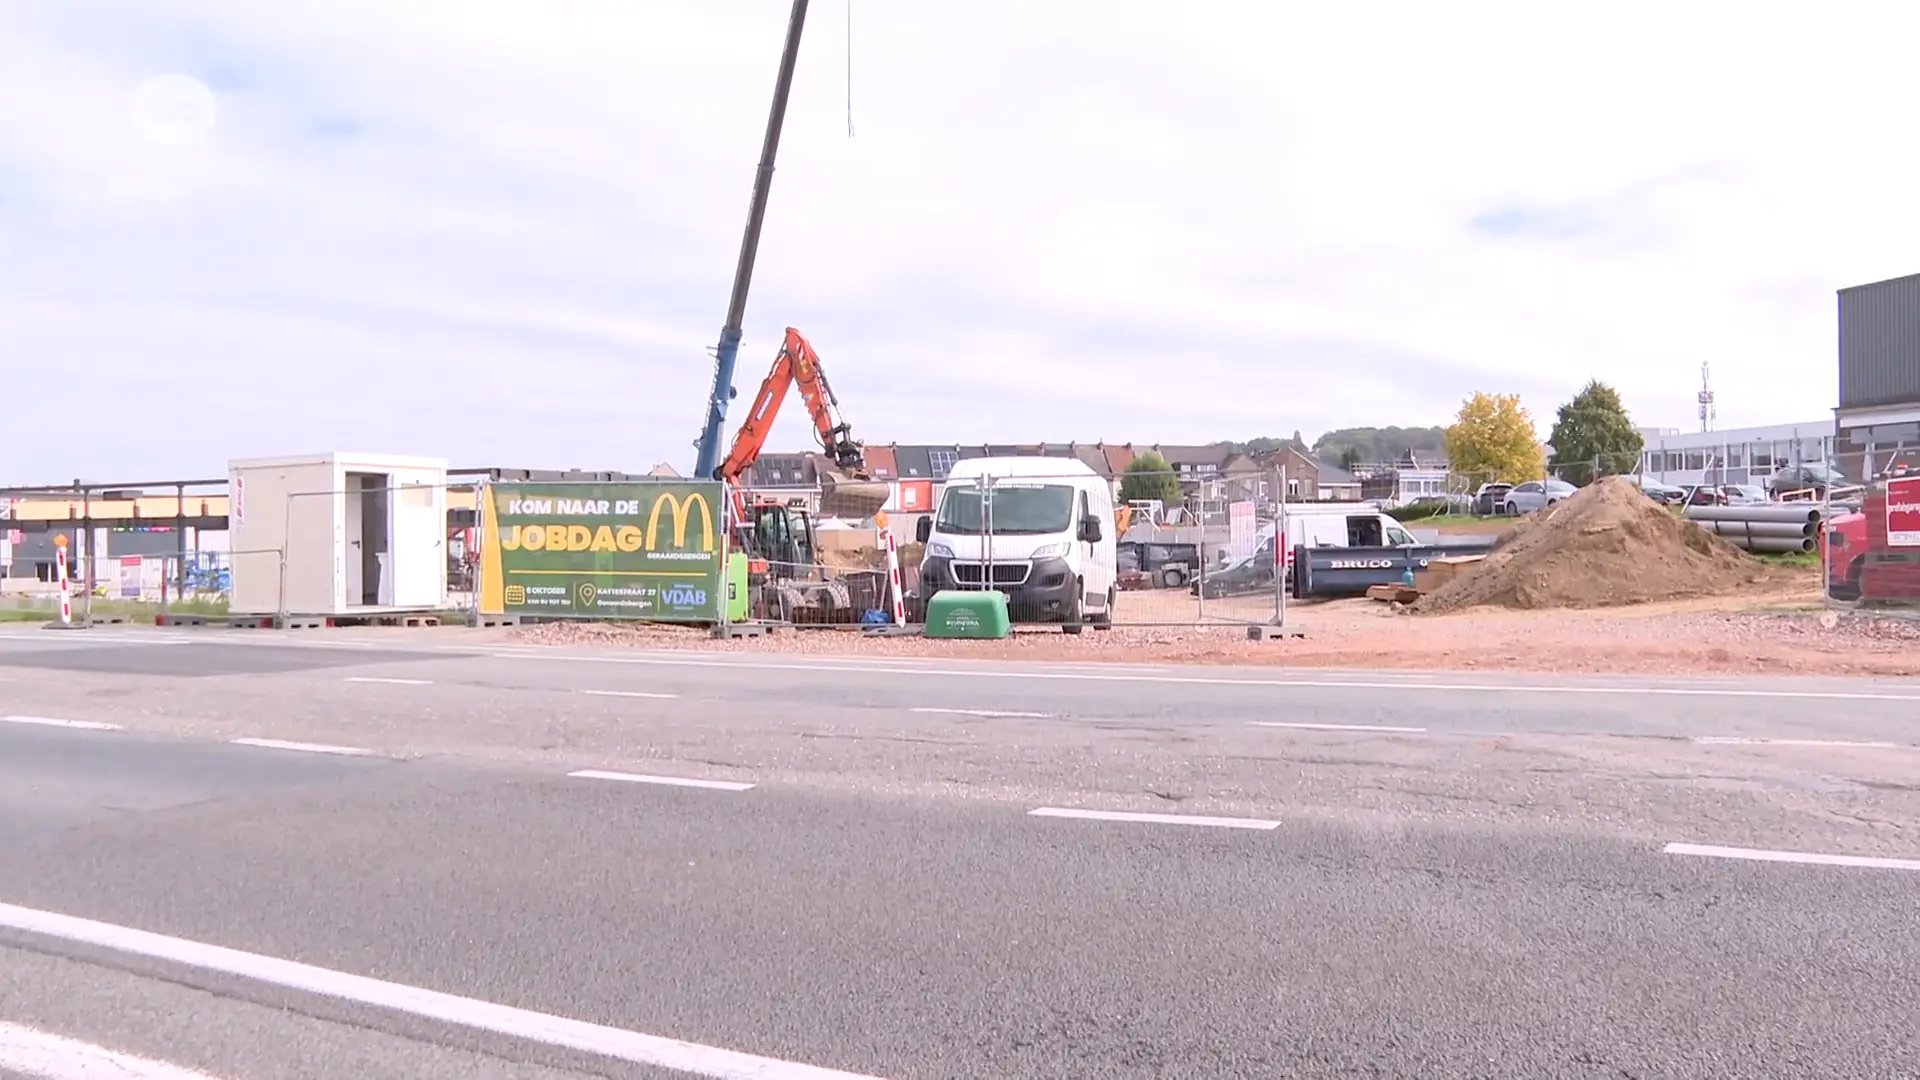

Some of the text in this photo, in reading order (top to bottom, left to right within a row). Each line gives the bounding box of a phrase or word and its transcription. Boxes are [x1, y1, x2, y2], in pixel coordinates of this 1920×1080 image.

[509, 500, 639, 515] KOM NAAR DE
[501, 525, 642, 552] JOBDAG
[646, 552, 711, 560] GERAARDSBERGEN
[1331, 559, 1393, 569] BRUCO
[661, 589, 707, 605] VDAB
